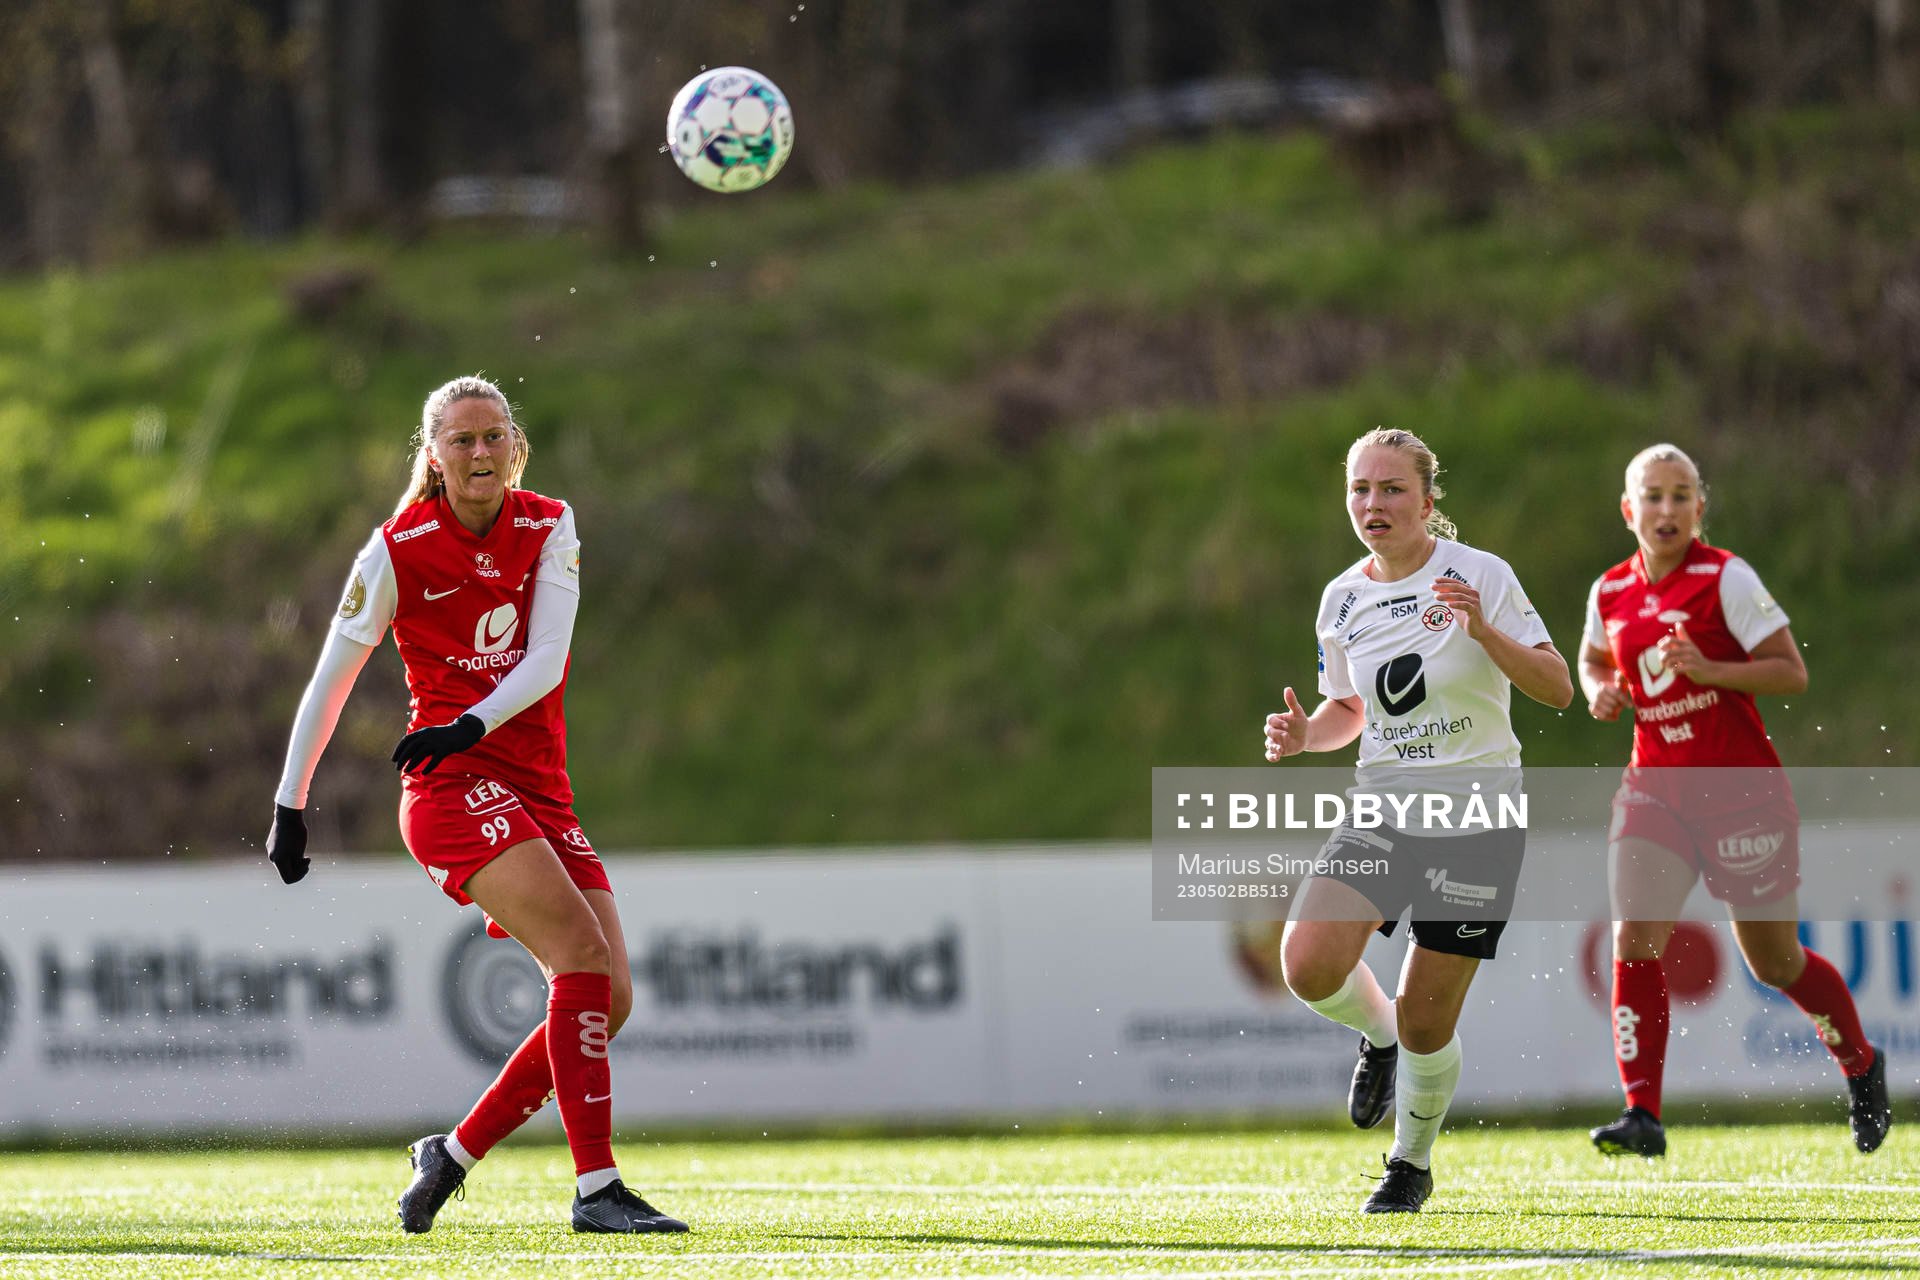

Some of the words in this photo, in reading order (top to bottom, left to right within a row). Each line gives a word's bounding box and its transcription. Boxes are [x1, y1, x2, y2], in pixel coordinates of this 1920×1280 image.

[1391, 602, 1418, 619] RSM
[1659, 721, 1695, 744] Vest
[1393, 742, 1436, 759] Vest
[481, 816, 511, 846] 99
